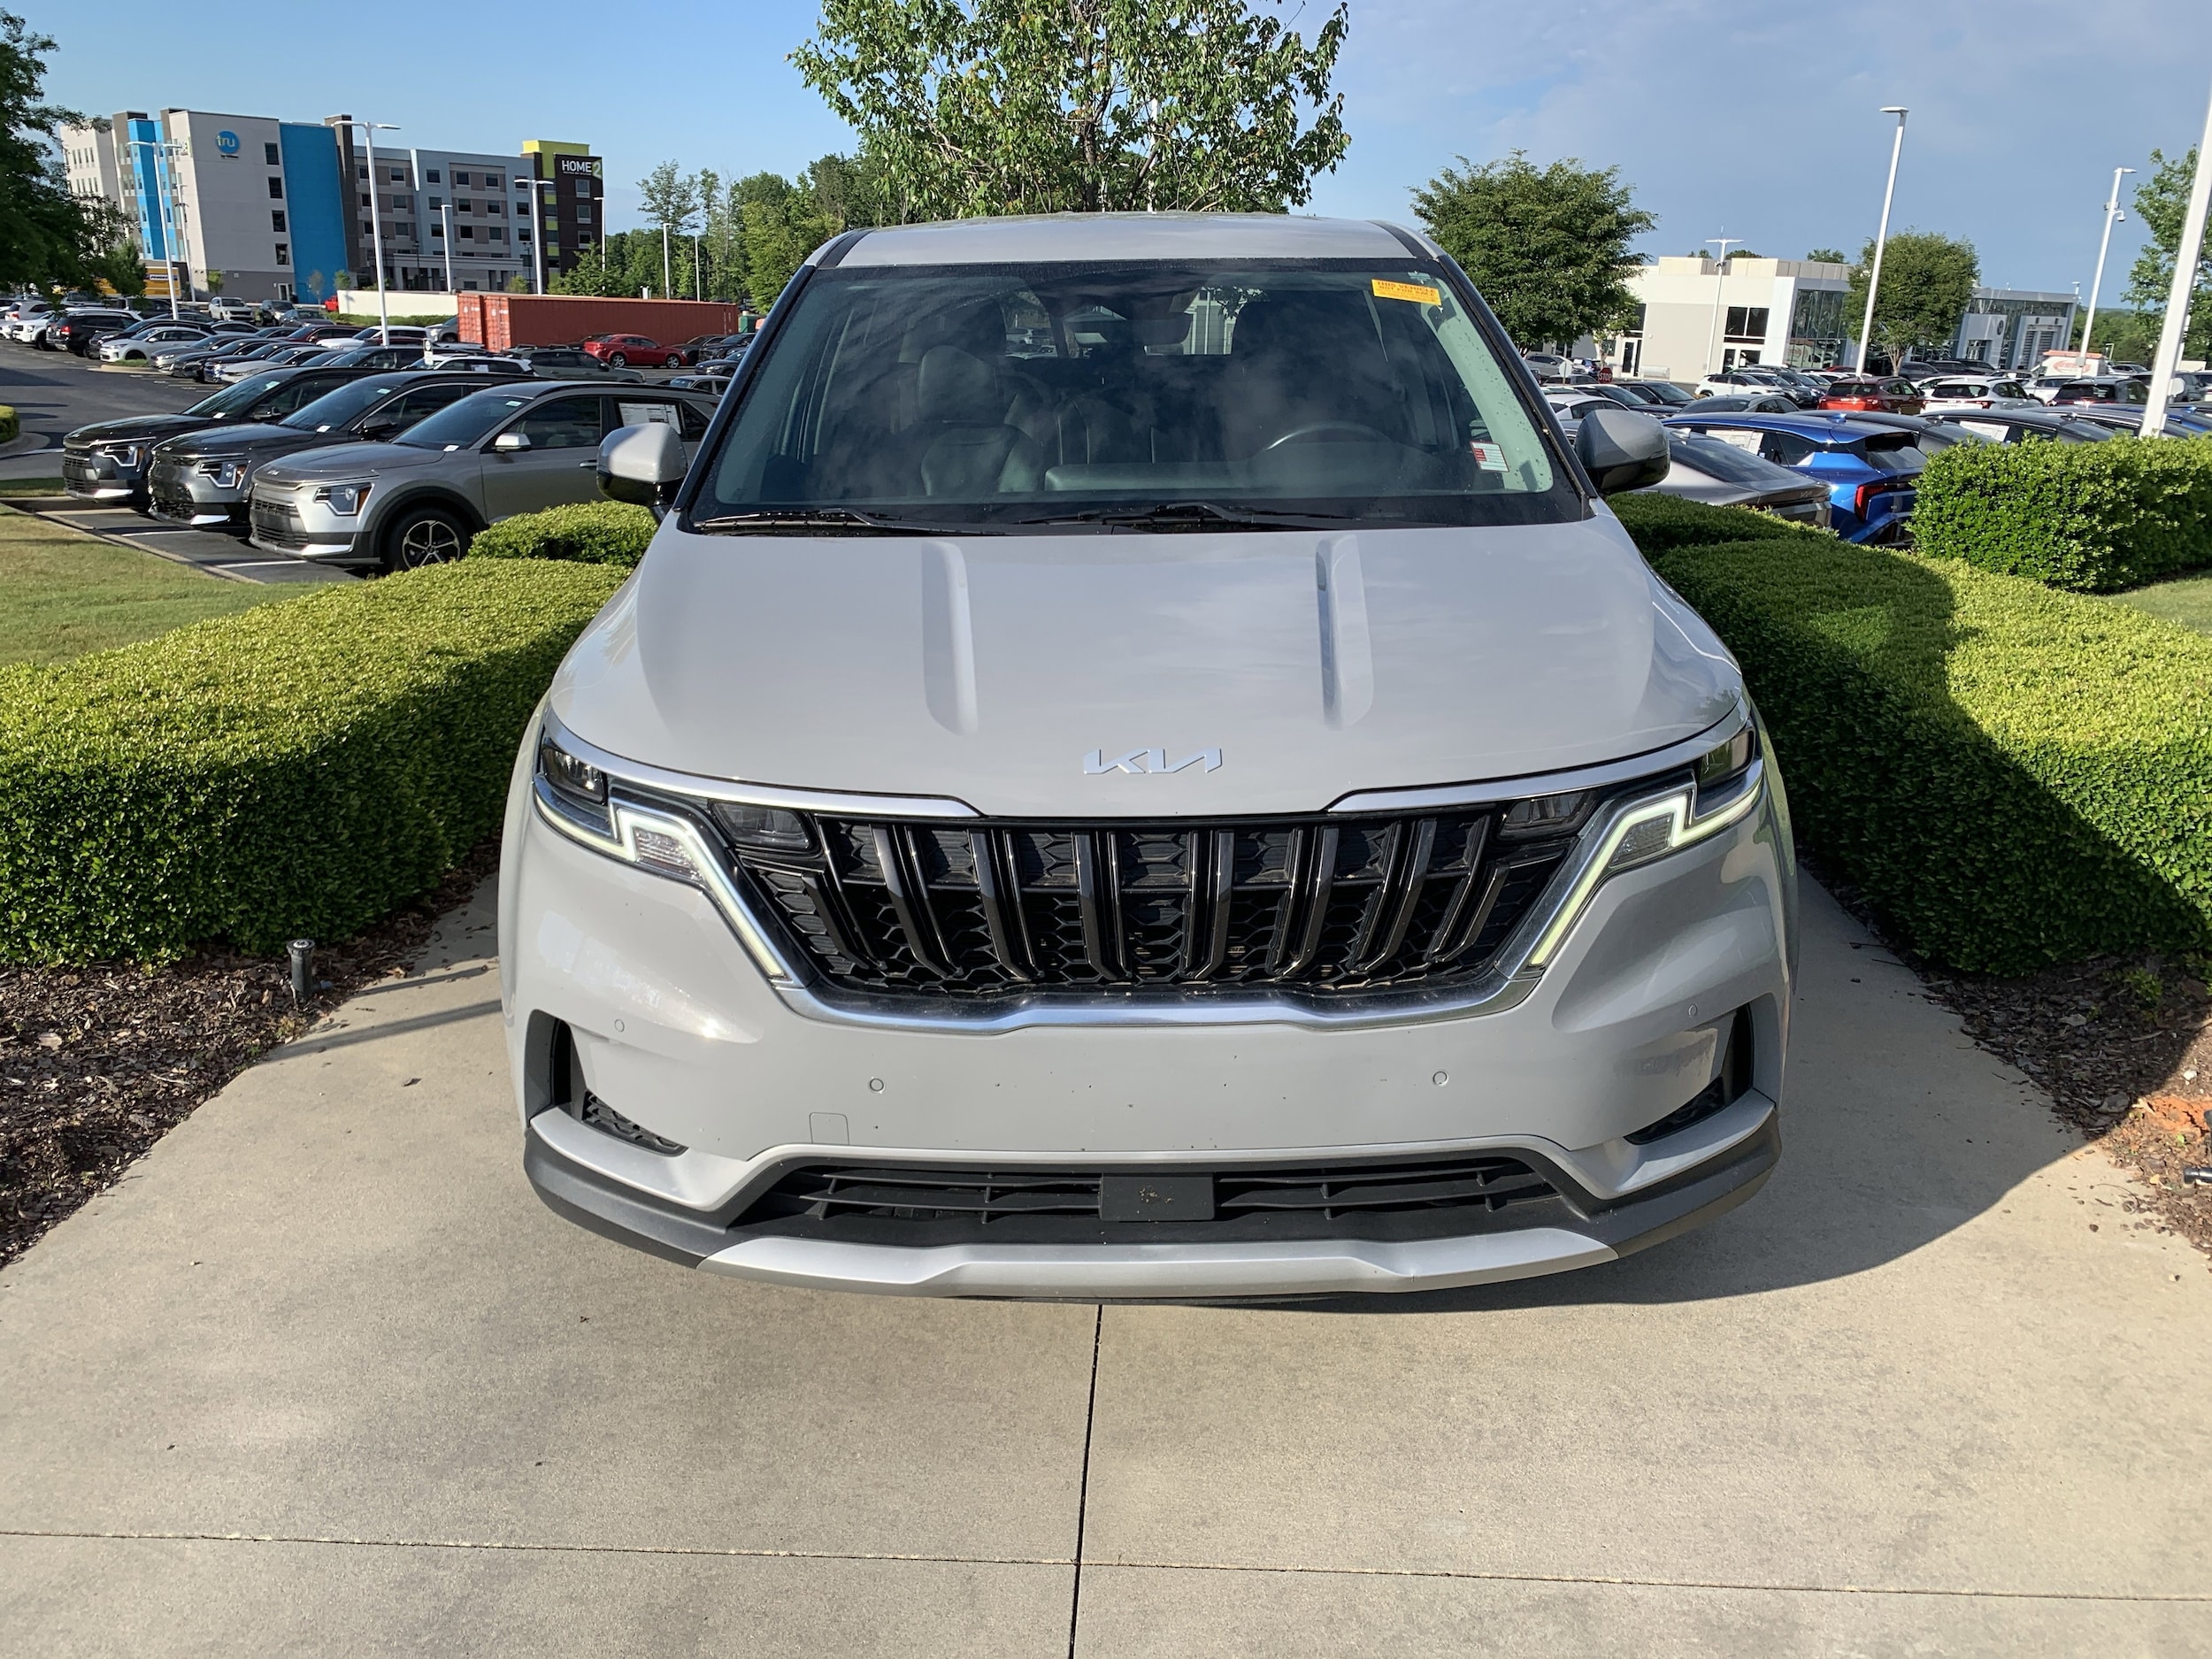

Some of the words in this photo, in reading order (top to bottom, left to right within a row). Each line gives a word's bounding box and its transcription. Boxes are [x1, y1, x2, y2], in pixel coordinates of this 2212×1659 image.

[216, 134, 235, 147] tru
[561, 159, 592, 173] HOME
[593, 161, 602, 178] 2
[1399, 284, 1434, 293] VEHICLE
[1598, 373, 1612, 381] STOP
[1083, 748, 1223, 775] KIA
